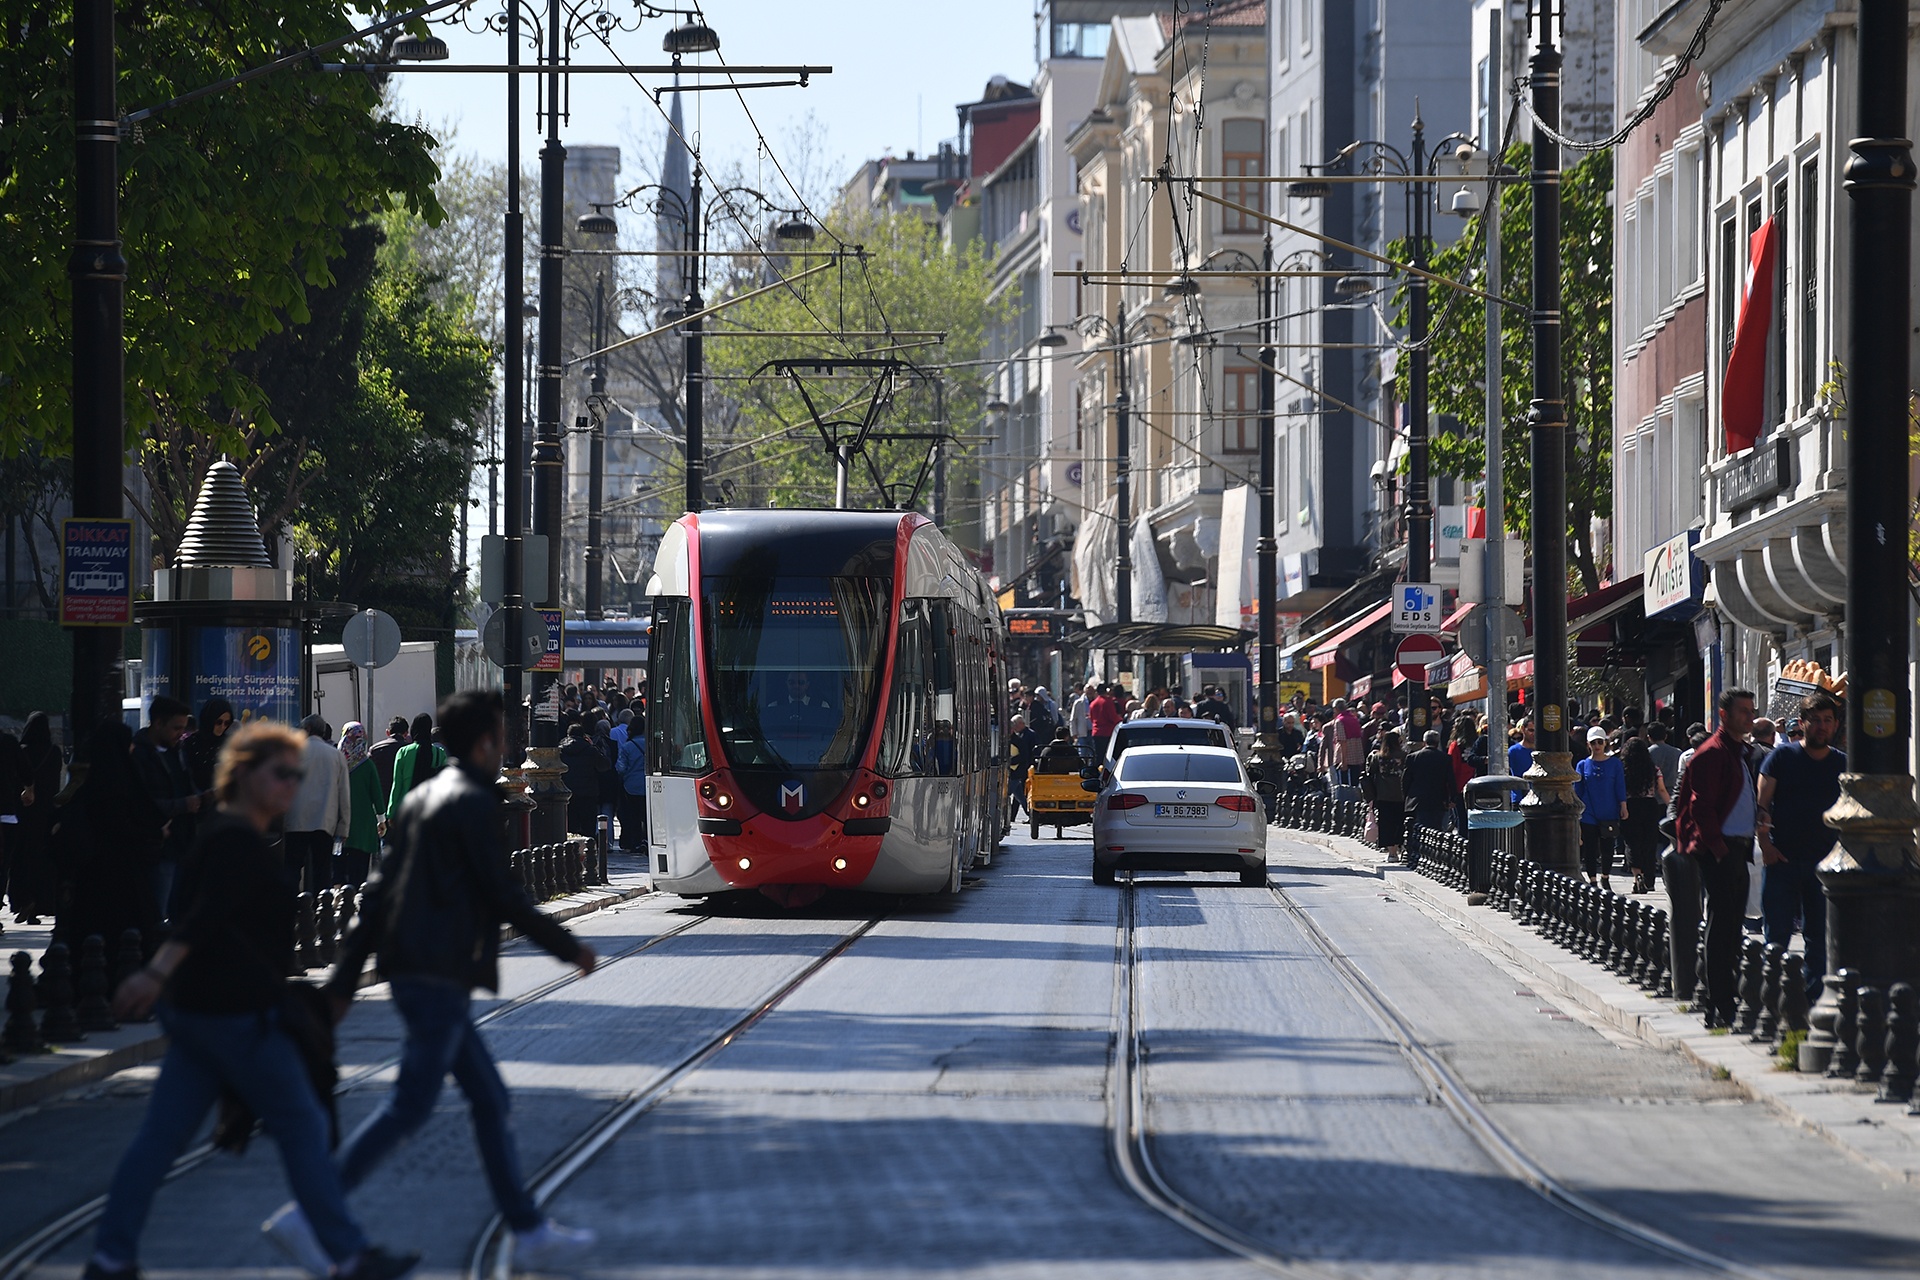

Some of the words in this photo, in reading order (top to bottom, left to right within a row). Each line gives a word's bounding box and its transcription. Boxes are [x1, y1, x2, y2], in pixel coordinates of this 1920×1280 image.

[67, 525, 128, 542] DİKKAT
[66, 546, 128, 558] TRAMVAY
[65, 597, 97, 606] Tramvay
[540, 613, 561, 623] KAT
[1401, 611, 1431, 621] EDS
[547, 624, 561, 632] VAY
[638, 637, 649, 645] İST
[195, 674, 241, 687] Hediyeler
[244, 674, 275, 686] Sürpriz
[210, 685, 245, 697] Sürpriz
[247, 686, 274, 696] Nokta
[1160, 806, 1170, 815] 34
[1173, 806, 1184, 815] BG
[1186, 806, 1206, 816] 7983
